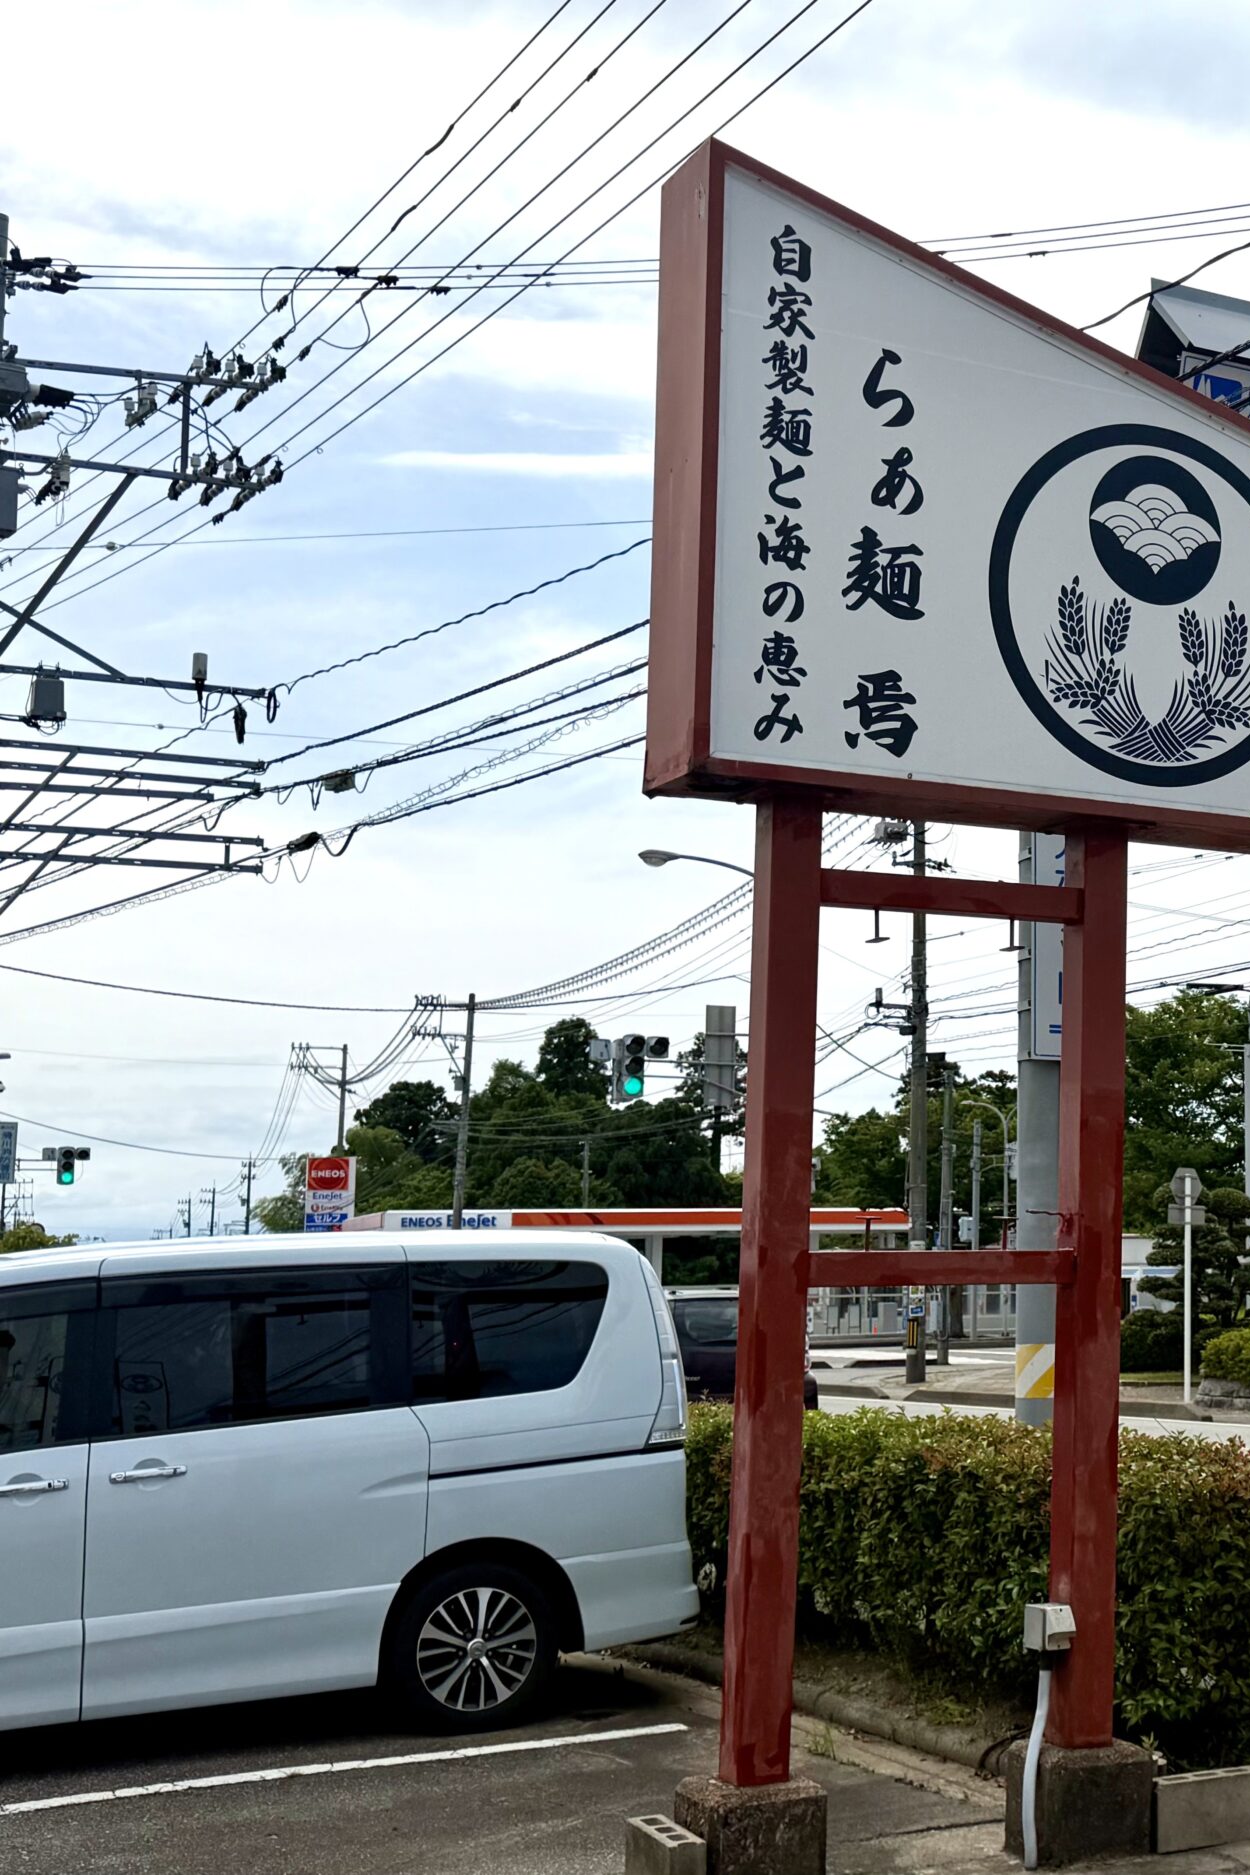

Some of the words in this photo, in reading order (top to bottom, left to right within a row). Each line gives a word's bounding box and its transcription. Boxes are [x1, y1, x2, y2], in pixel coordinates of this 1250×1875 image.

[753, 224, 816, 743] 自家製麺と海の恵み
[311, 1169, 346, 1178] ENEOS
[314, 1213, 341, 1223] セルフ
[401, 1217, 442, 1229] ENEOS
